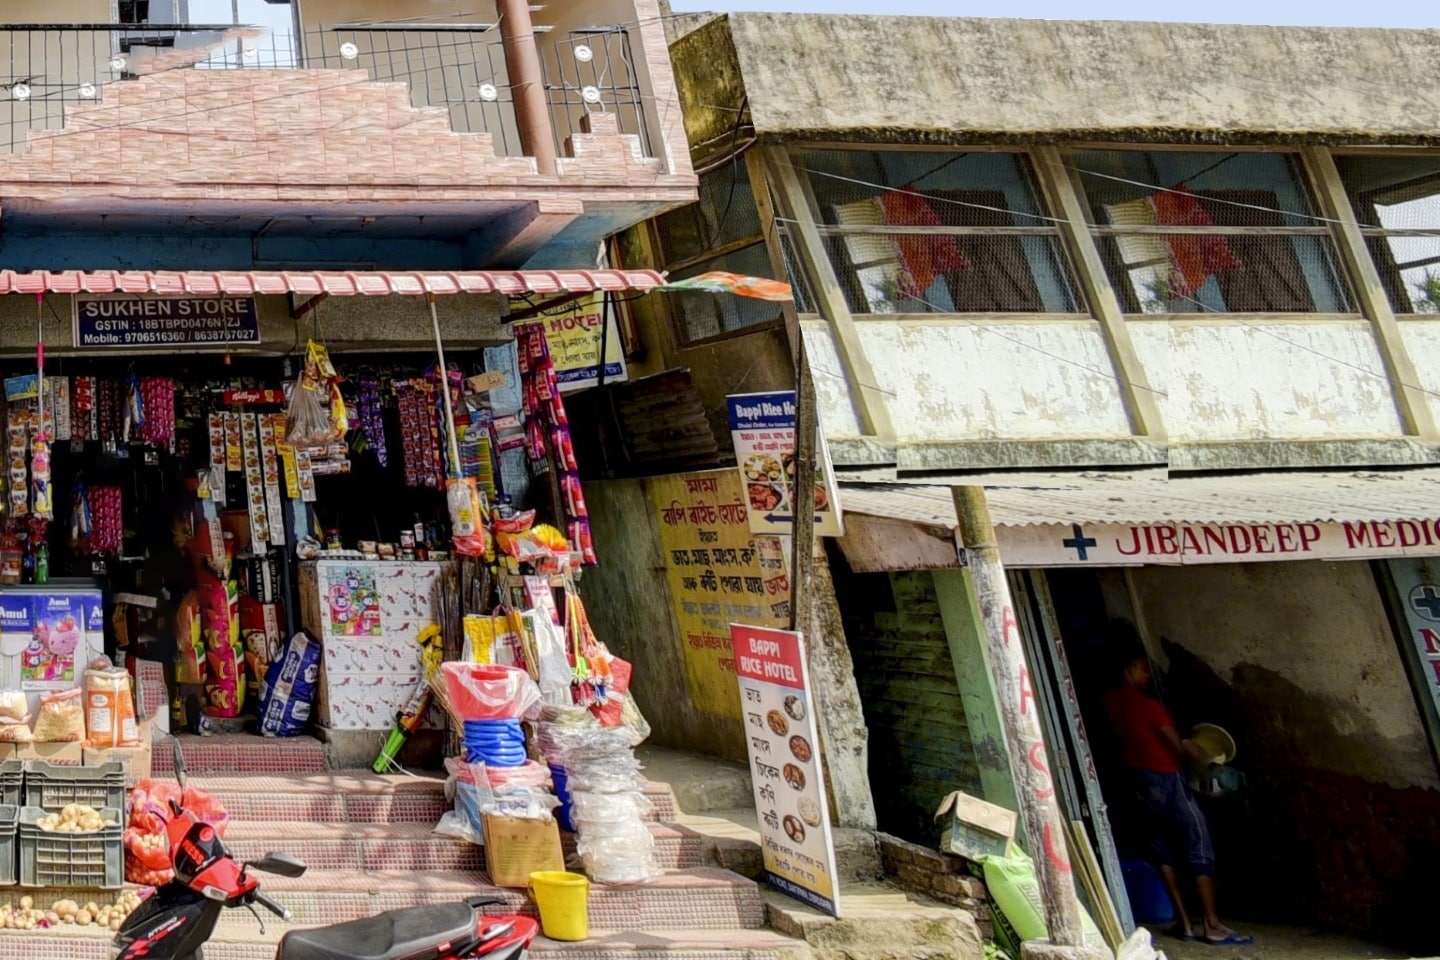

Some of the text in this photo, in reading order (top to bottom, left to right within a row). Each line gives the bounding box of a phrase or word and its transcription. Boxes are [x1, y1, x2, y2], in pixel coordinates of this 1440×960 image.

[86, 299, 248, 317] SUKHEN STORE
[95, 320, 129, 331] GSTIN
[84, 334, 122, 344] Mobile:
[125, 332, 185, 342] 9706516360
[735, 403, 762, 421] Bappi
[718, 498, 748, 527] হোটে
[1116, 522, 1321, 555] JIBANDEEP
[48, 597, 69, 606] Amul
[749, 638, 781, 658] BAPPI
[740, 656, 798, 682] RICE HOTEL
